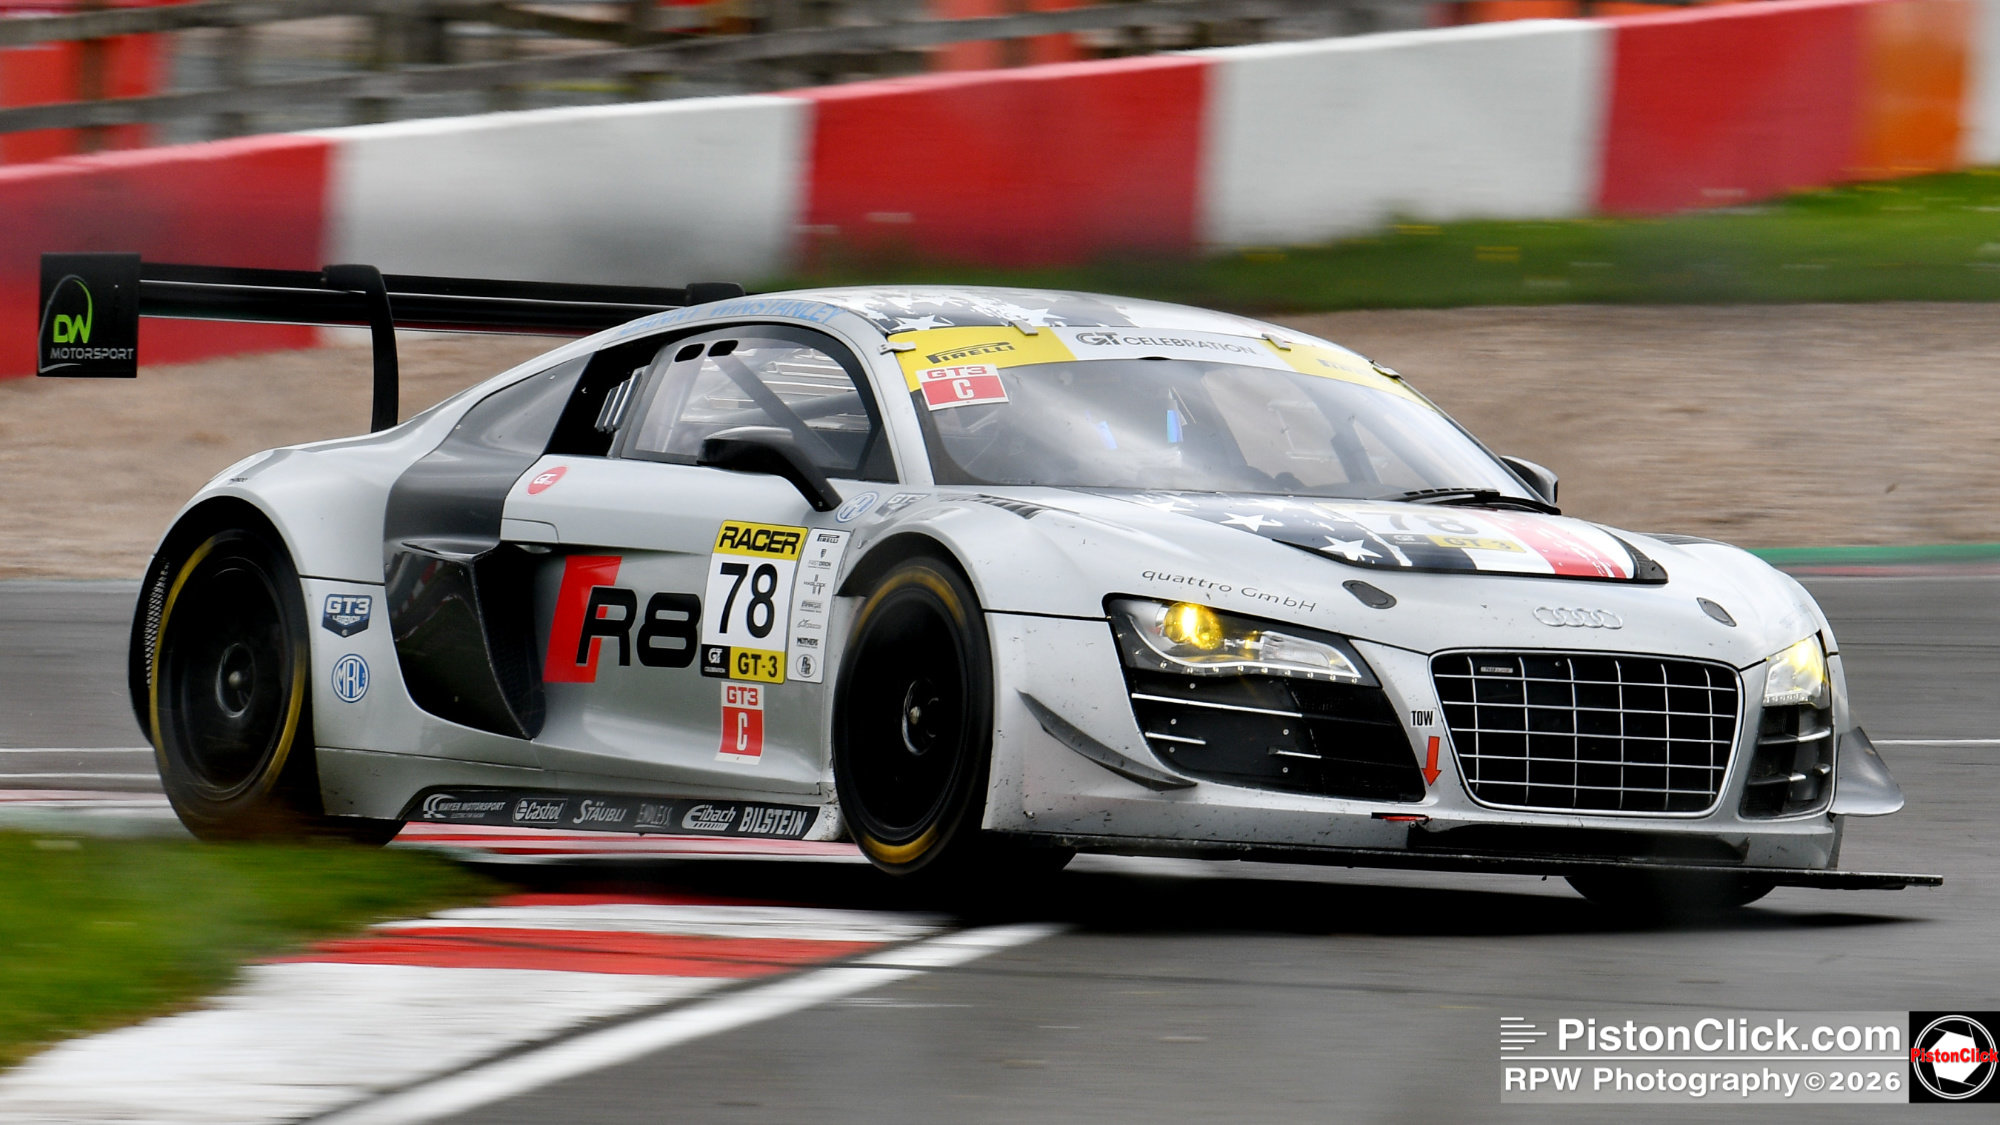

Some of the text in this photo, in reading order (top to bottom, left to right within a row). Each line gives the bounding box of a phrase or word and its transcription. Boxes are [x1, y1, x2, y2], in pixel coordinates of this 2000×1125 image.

[709, 300, 845, 325] WINSTANLEY
[53, 314, 93, 344] DW
[50, 347, 134, 360] MOTORSPORT
[926, 341, 1015, 363] PIRELLI
[1076, 331, 1257, 355] GT CELEBRATION
[926, 365, 988, 380] GT3
[952, 378, 976, 400] C
[1355, 511, 1479, 534] 78
[719, 526, 800, 555] RACER
[817, 533, 840, 544] PIRELLI
[719, 562, 778, 639] 78
[1142, 569, 1317, 612] quattro GmbH
[325, 596, 370, 615] GT3
[576, 586, 702, 669] R8
[737, 652, 778, 678] GT-3
[335, 659, 366, 699] MRL
[727, 685, 758, 706] GT3
[1411, 710, 1433, 726] TOW
[736, 711, 748, 751] C
[462, 802, 506, 811] MOTORSPORT
[525, 802, 564, 820] Castrol
[573, 799, 627, 824] STÄUBLI
[682, 804, 737, 831] Eibach
[738, 806, 807, 836] BILSTEIN
